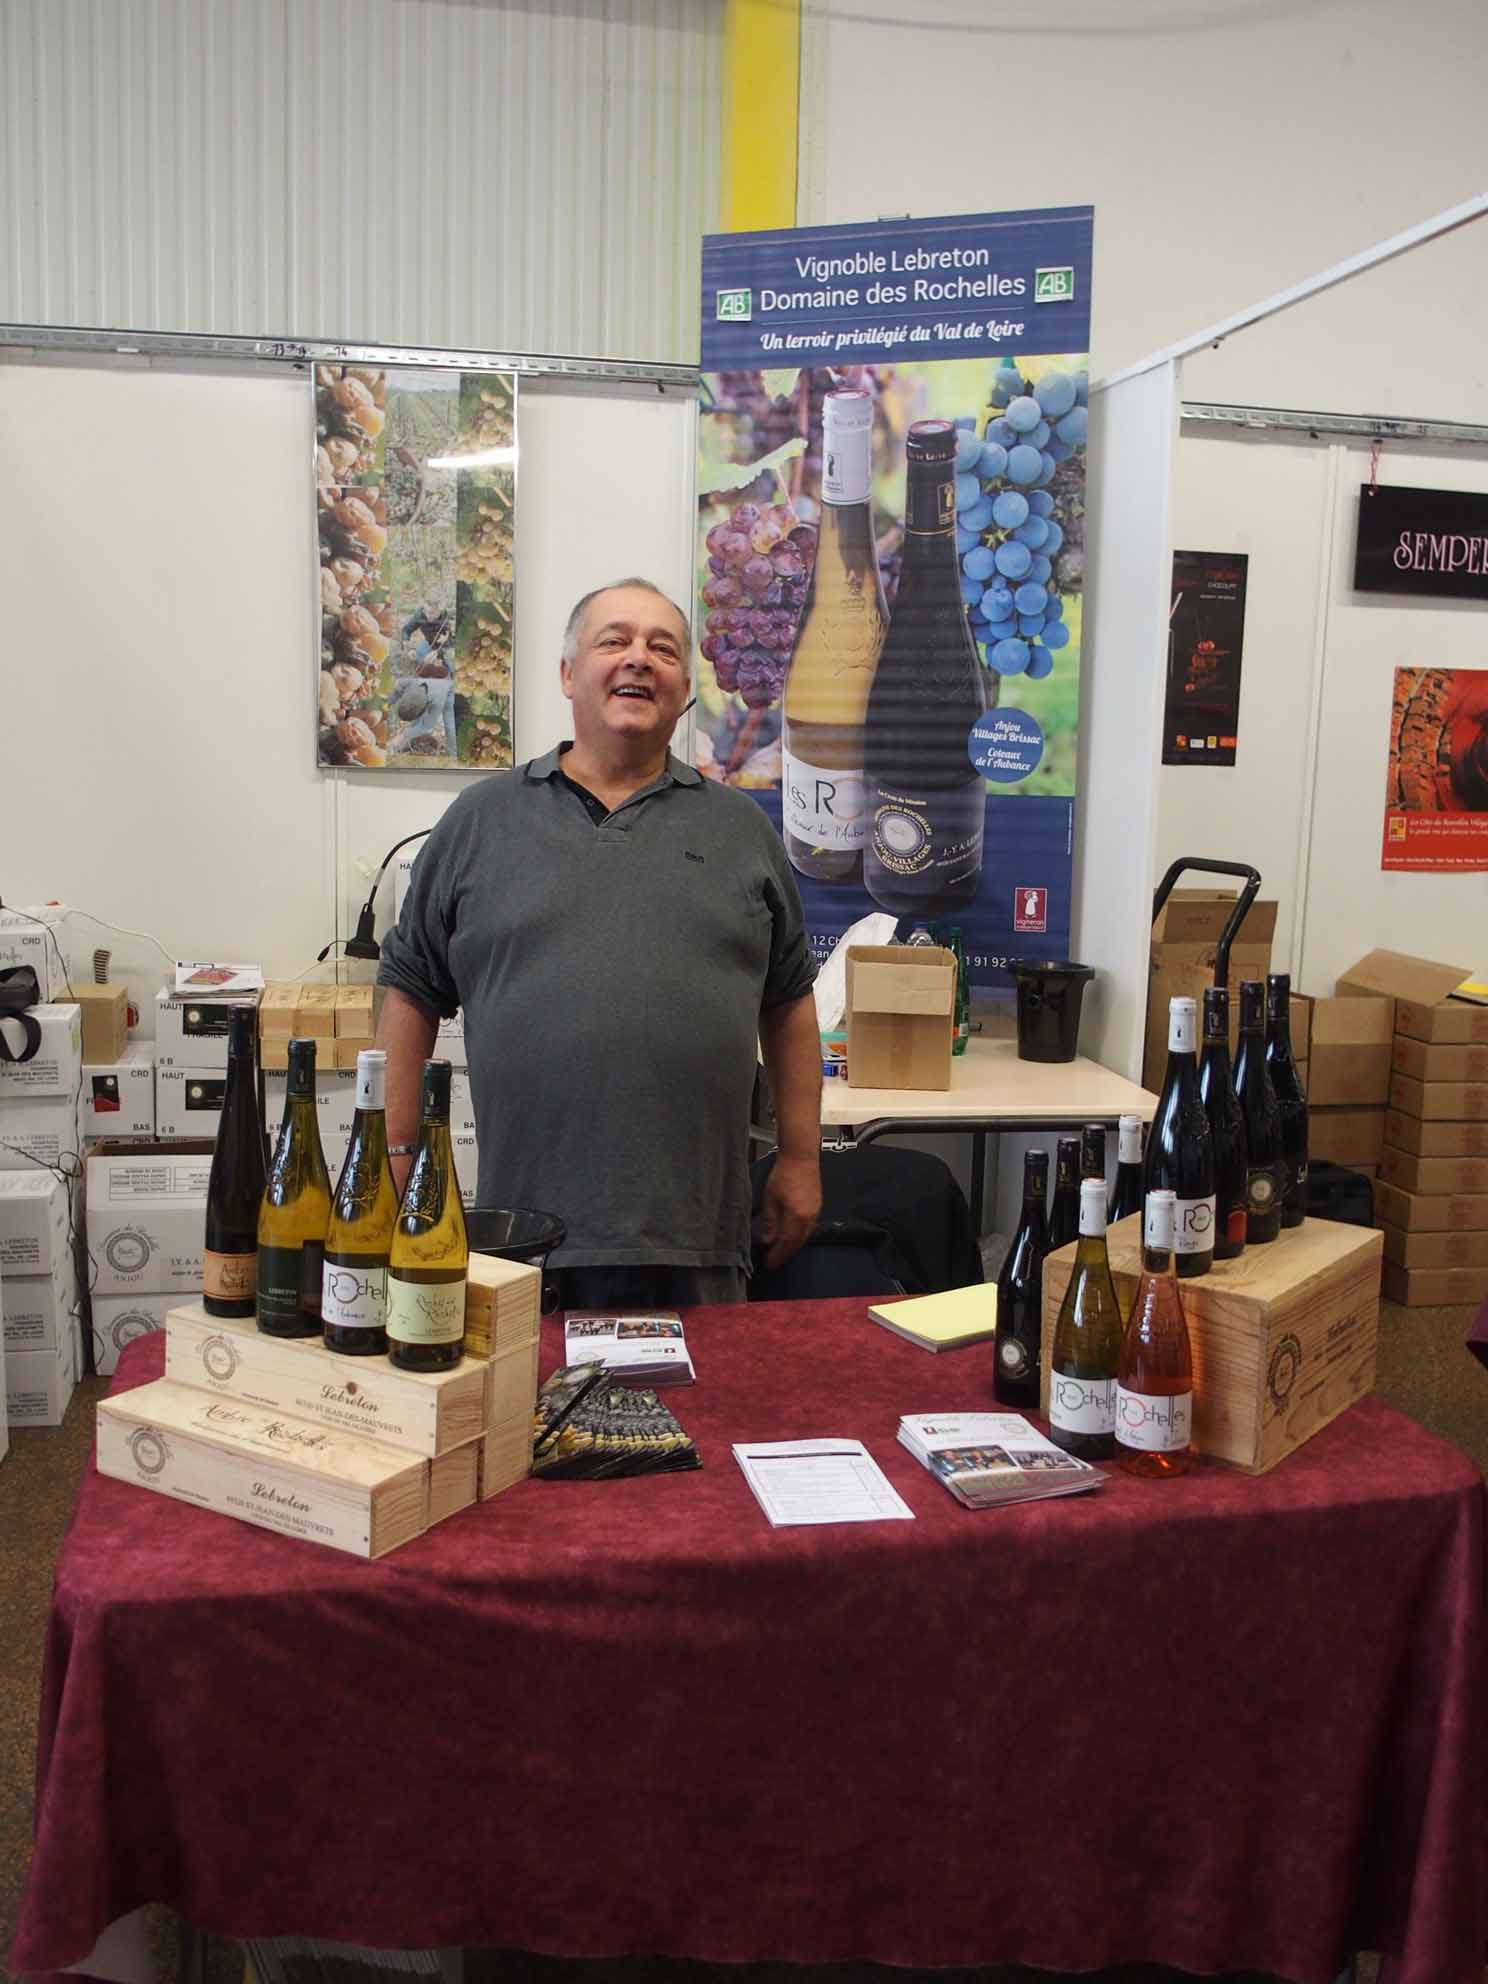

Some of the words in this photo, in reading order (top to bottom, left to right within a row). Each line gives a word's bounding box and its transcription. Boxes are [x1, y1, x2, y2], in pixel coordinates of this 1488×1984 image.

[795, 251, 887, 282] Vignoble
[891, 248, 989, 272] Lebreton
[1039, 273, 1067, 294] AB
[760, 286, 859, 311] Domaine
[866, 281, 907, 304] des
[914, 274, 1026, 301] Rochelles
[720, 294, 745, 315] AB
[760, 333, 784, 350] Un
[786, 330, 835, 348] terroir
[835, 325, 908, 350] privilégié
[910, 324, 931, 341] du
[934, 322, 962, 341] Val
[964, 321, 984, 338] de
[986, 319, 1025, 342] Loire
[994, 720, 1021, 734] Anjou
[972, 728, 1008, 742] Villages
[1008, 732, 1041, 745] Brissac
[987, 747, 1022, 760] Coteaux
[973, 956, 988, 968] 91
[991, 957, 1007, 968] 92
[130, 1069, 150, 1078] CRD
[161, 1072, 185, 1080] HAUT
[133, 1123, 150, 1132] BAS
[463, 1121, 475, 1129] BA
[456, 1138, 475, 1146] CRD
